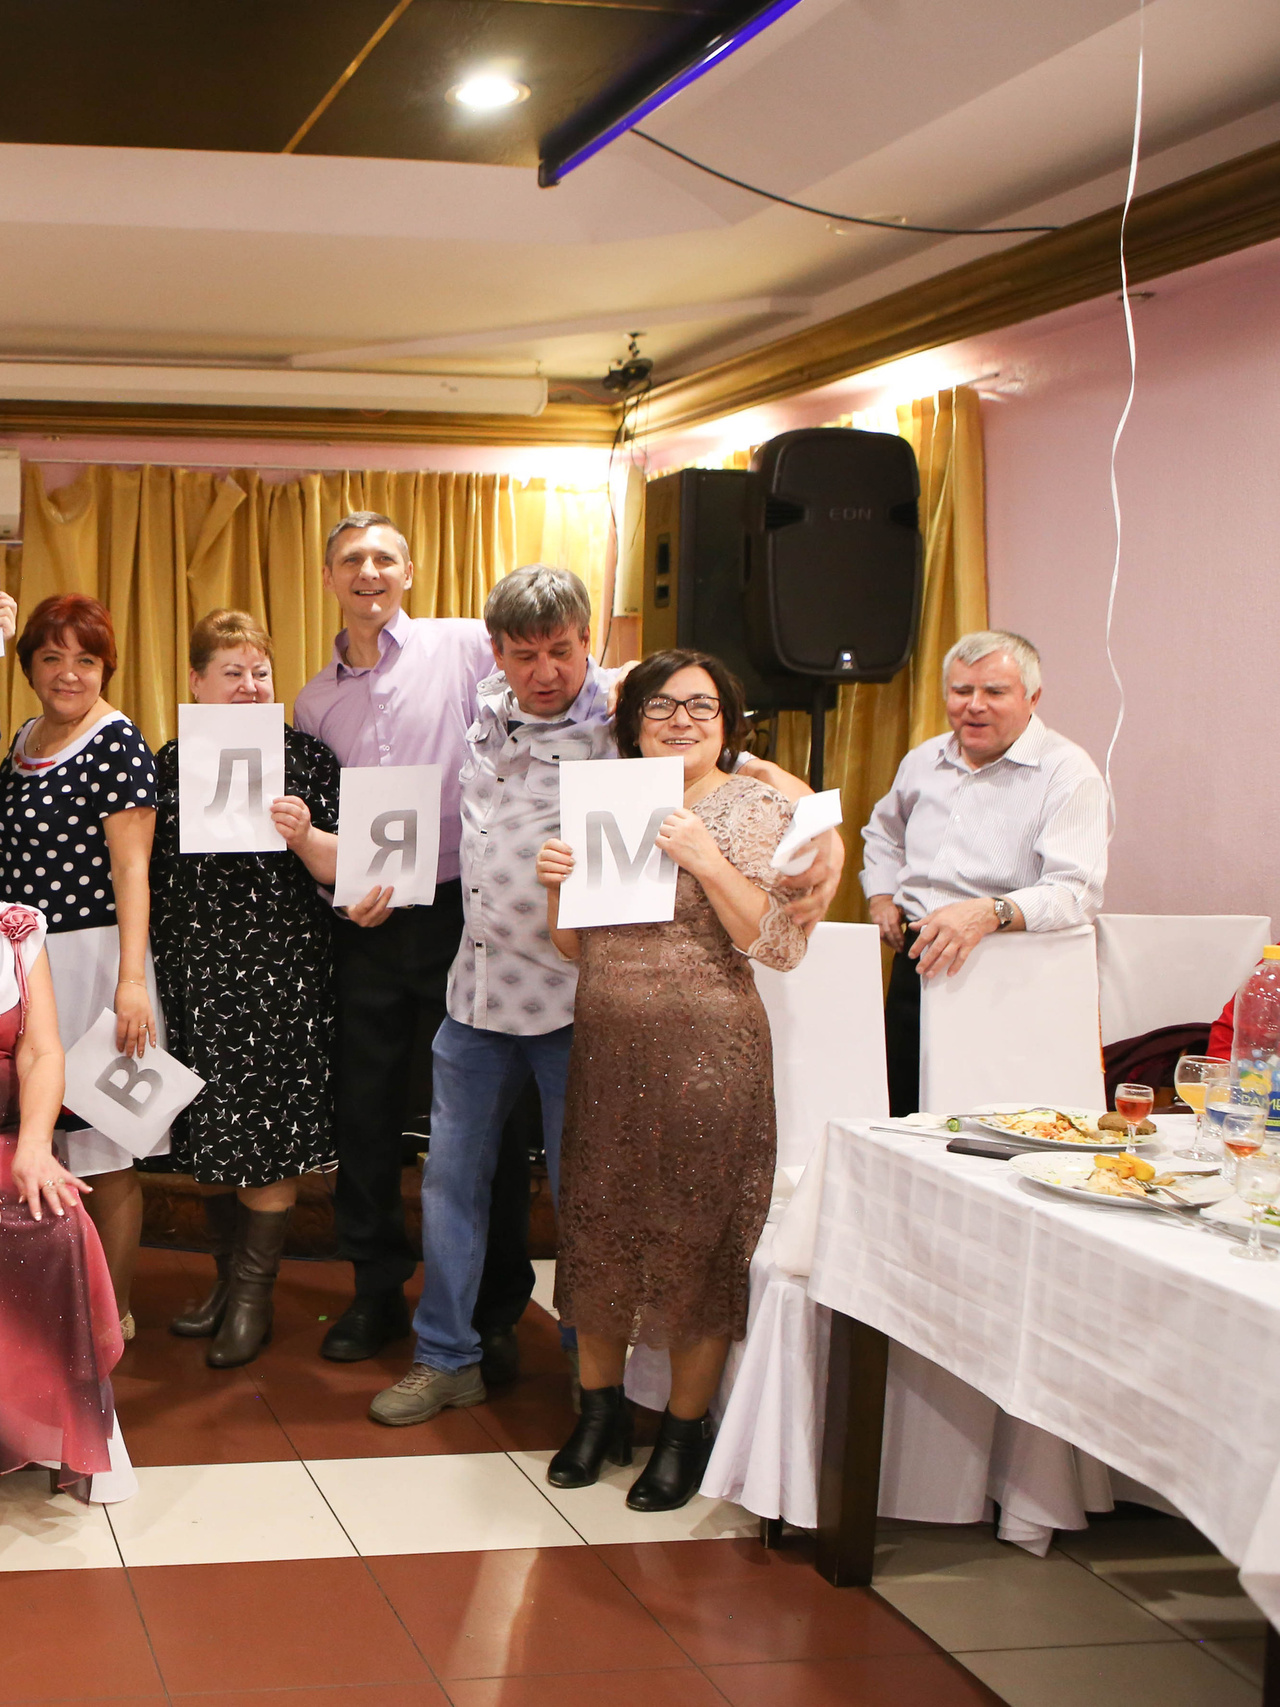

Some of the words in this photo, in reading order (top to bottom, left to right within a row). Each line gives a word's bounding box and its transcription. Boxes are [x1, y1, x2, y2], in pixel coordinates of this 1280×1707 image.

[204, 748, 263, 818] Л
[365, 809, 418, 877] Я
[585, 807, 678, 890] М
[94, 1055, 164, 1119] В
